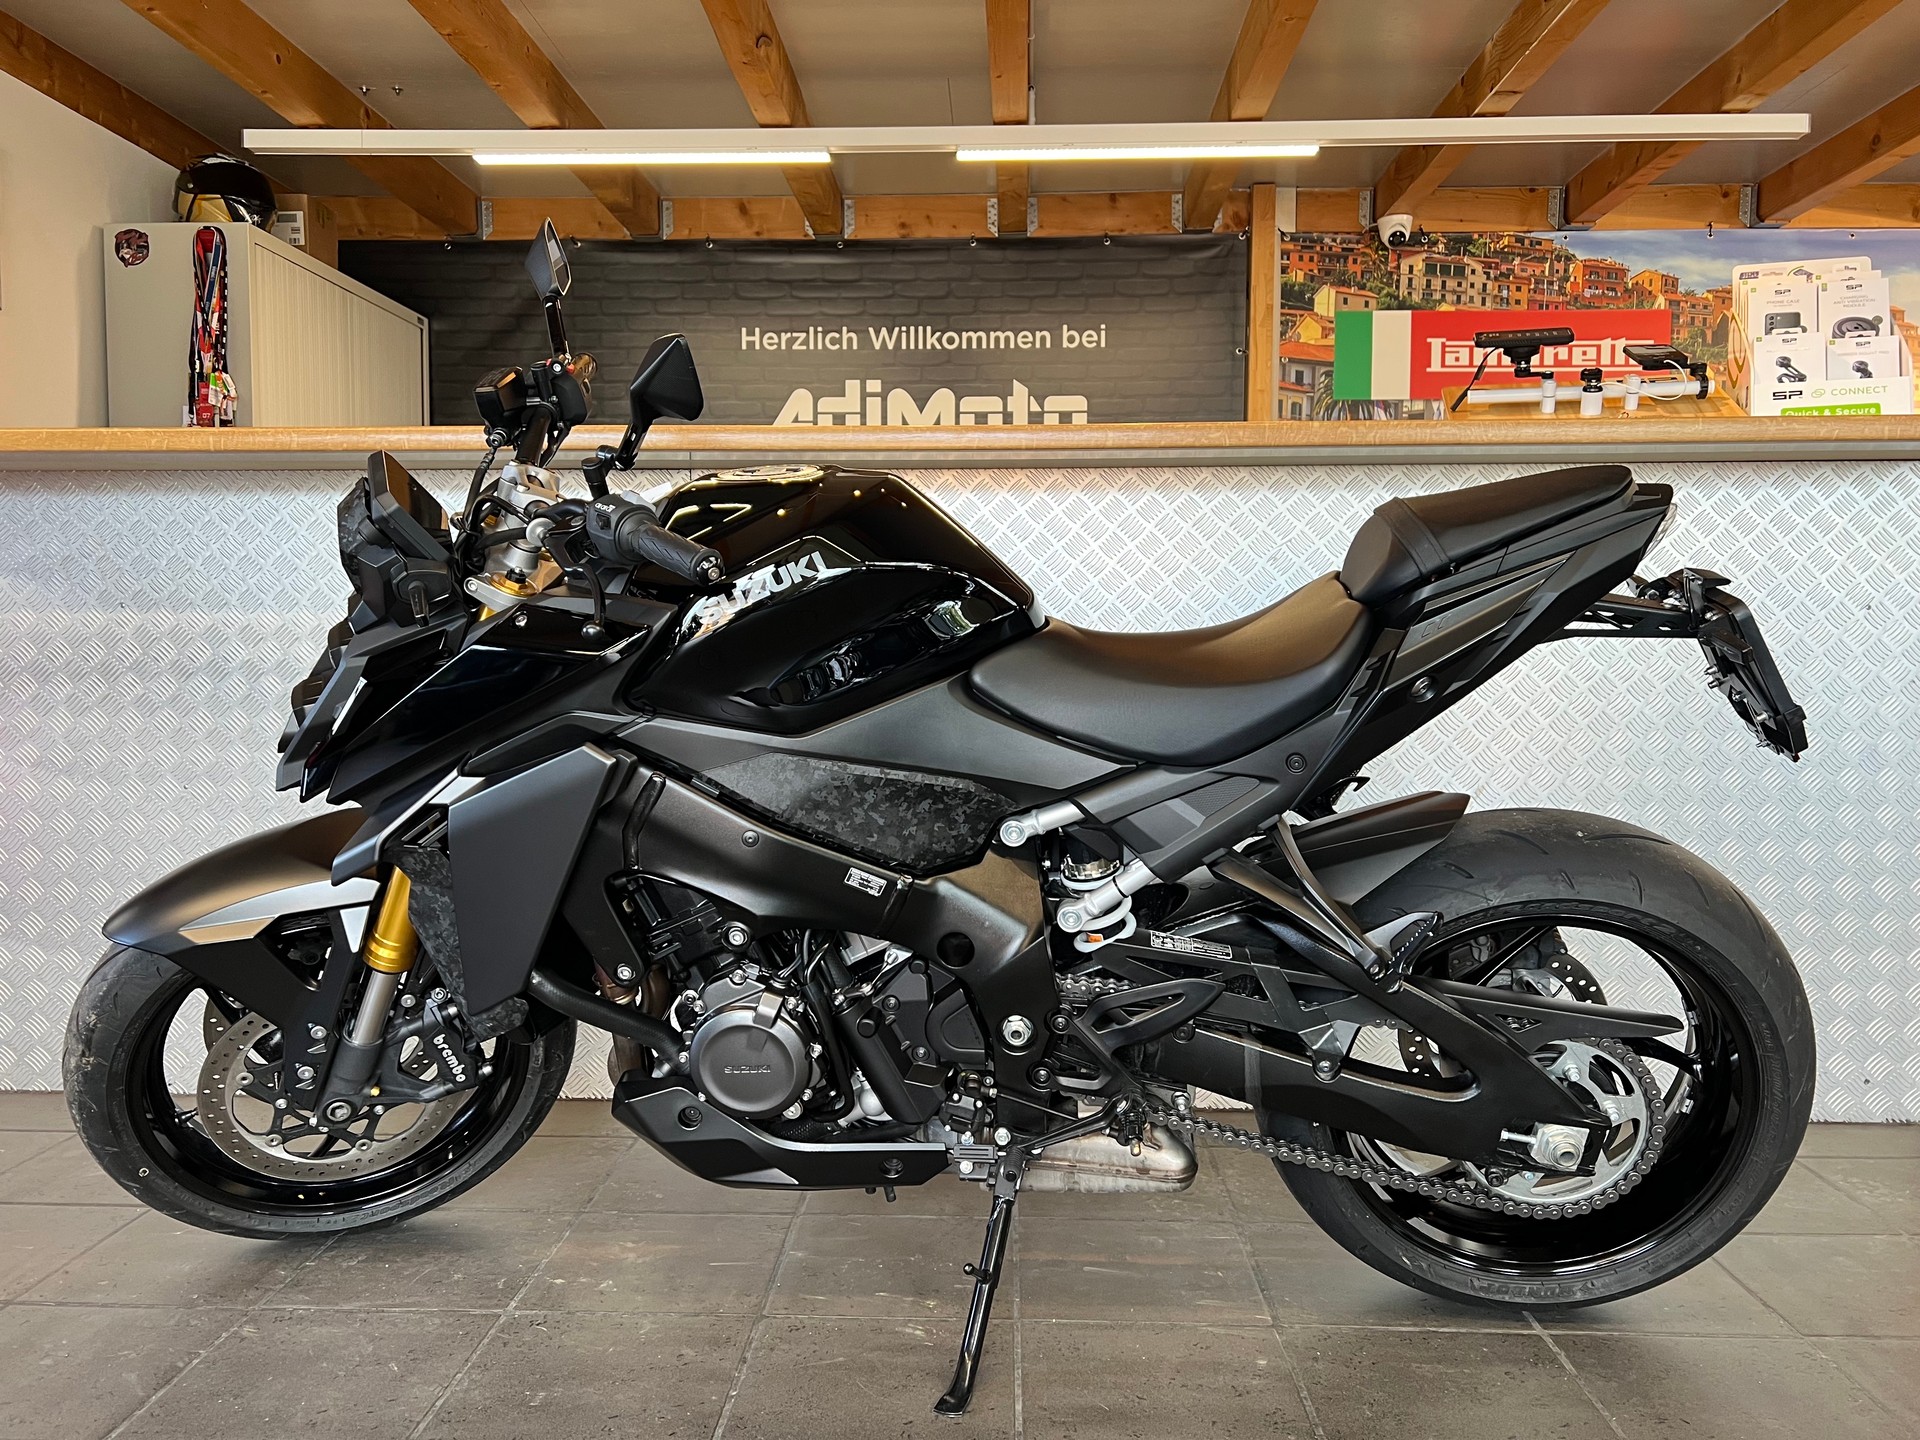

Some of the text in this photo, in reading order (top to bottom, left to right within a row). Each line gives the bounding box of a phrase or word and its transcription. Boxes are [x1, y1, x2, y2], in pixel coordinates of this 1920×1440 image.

[740, 323, 1107, 350] Herzlich Willkommen bei
[1772, 385, 1889, 401] SP CONNECT
[1835, 406, 1877, 416] Secure
[695, 551, 828, 626] SUZUKI
[433, 1034, 466, 1083] brembo
[724, 1064, 771, 1074] SUZUKI
